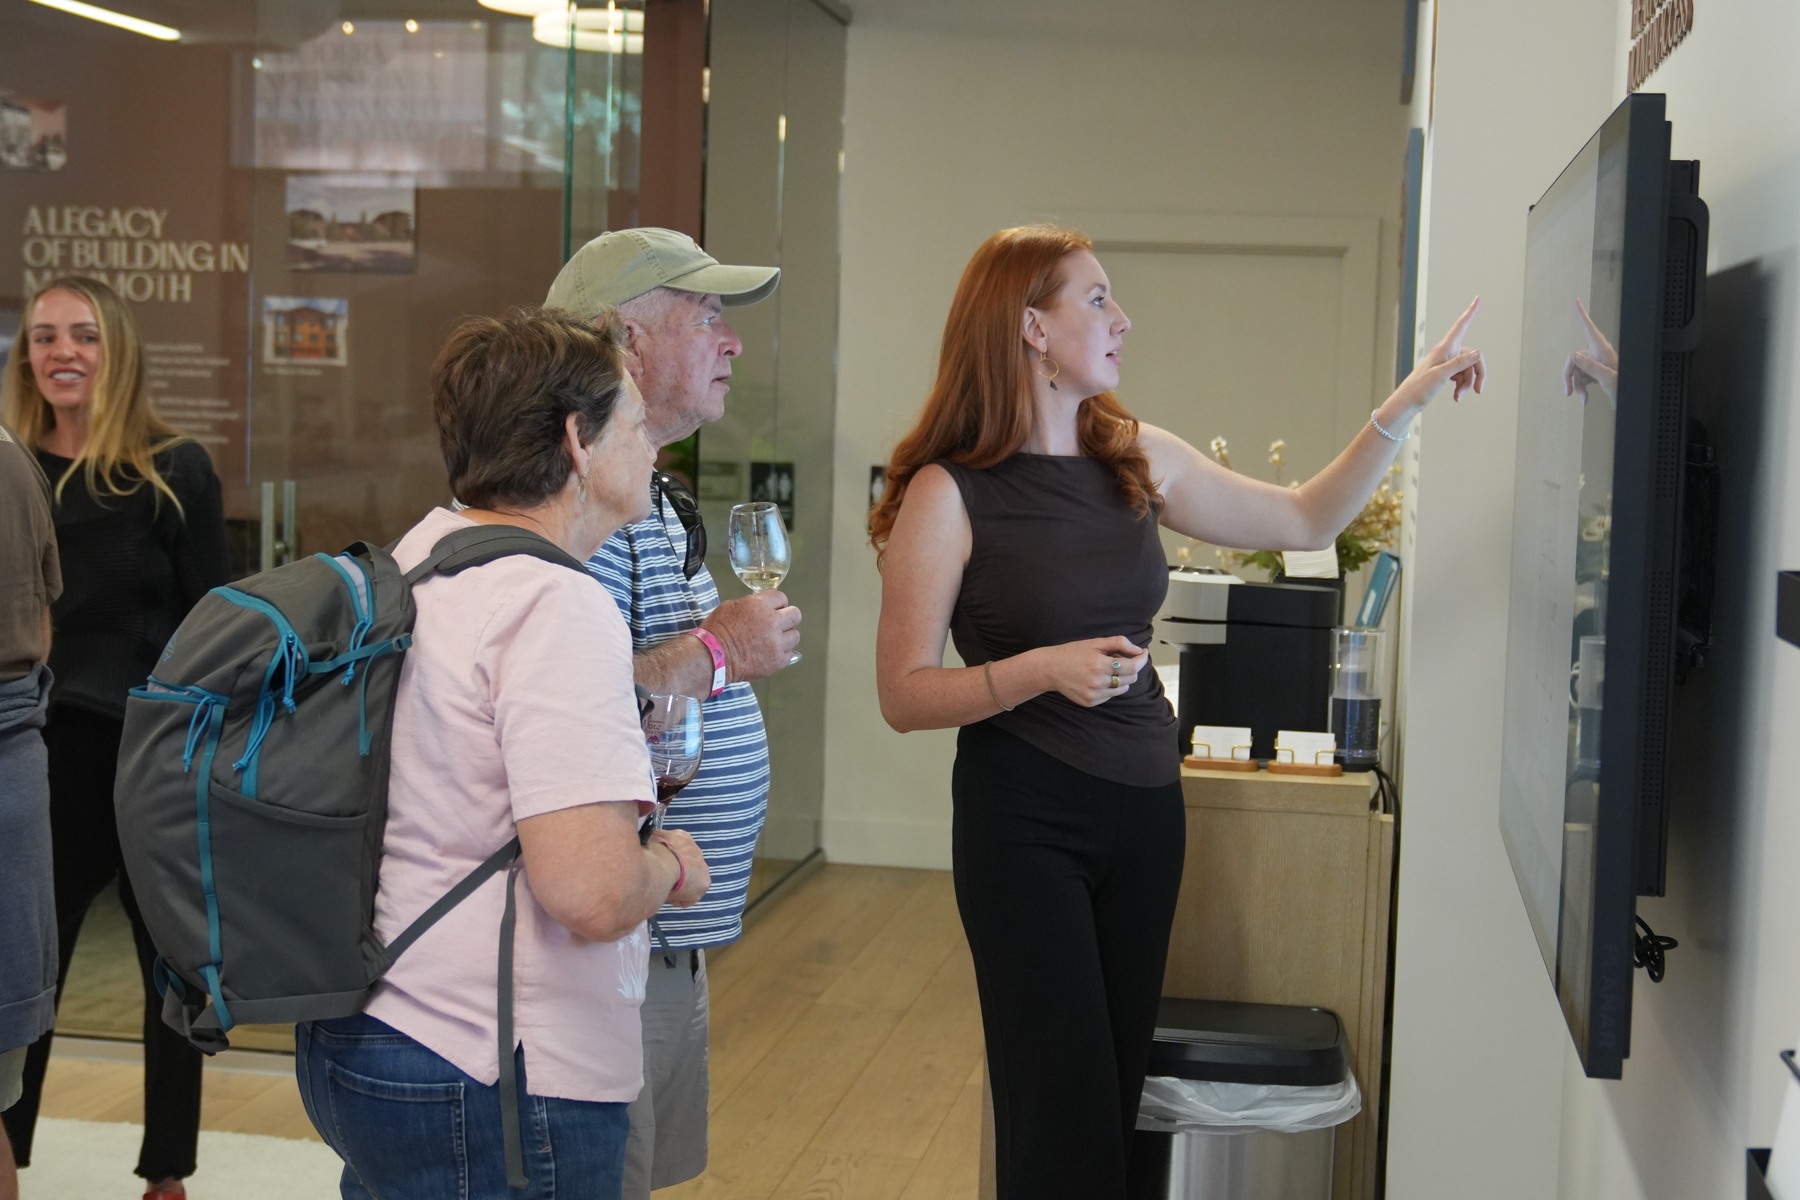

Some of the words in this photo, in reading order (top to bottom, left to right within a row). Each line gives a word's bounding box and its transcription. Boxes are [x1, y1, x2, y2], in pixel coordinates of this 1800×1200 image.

[22, 206, 44, 235] A
[48, 206, 167, 238] LEGACY
[23, 238, 67, 267] OF
[71, 240, 215, 272] BUILDING
[220, 243, 249, 272] IN
[23, 269, 192, 303] MMOTH
[1599, 944, 1619, 1048] PLANAR
